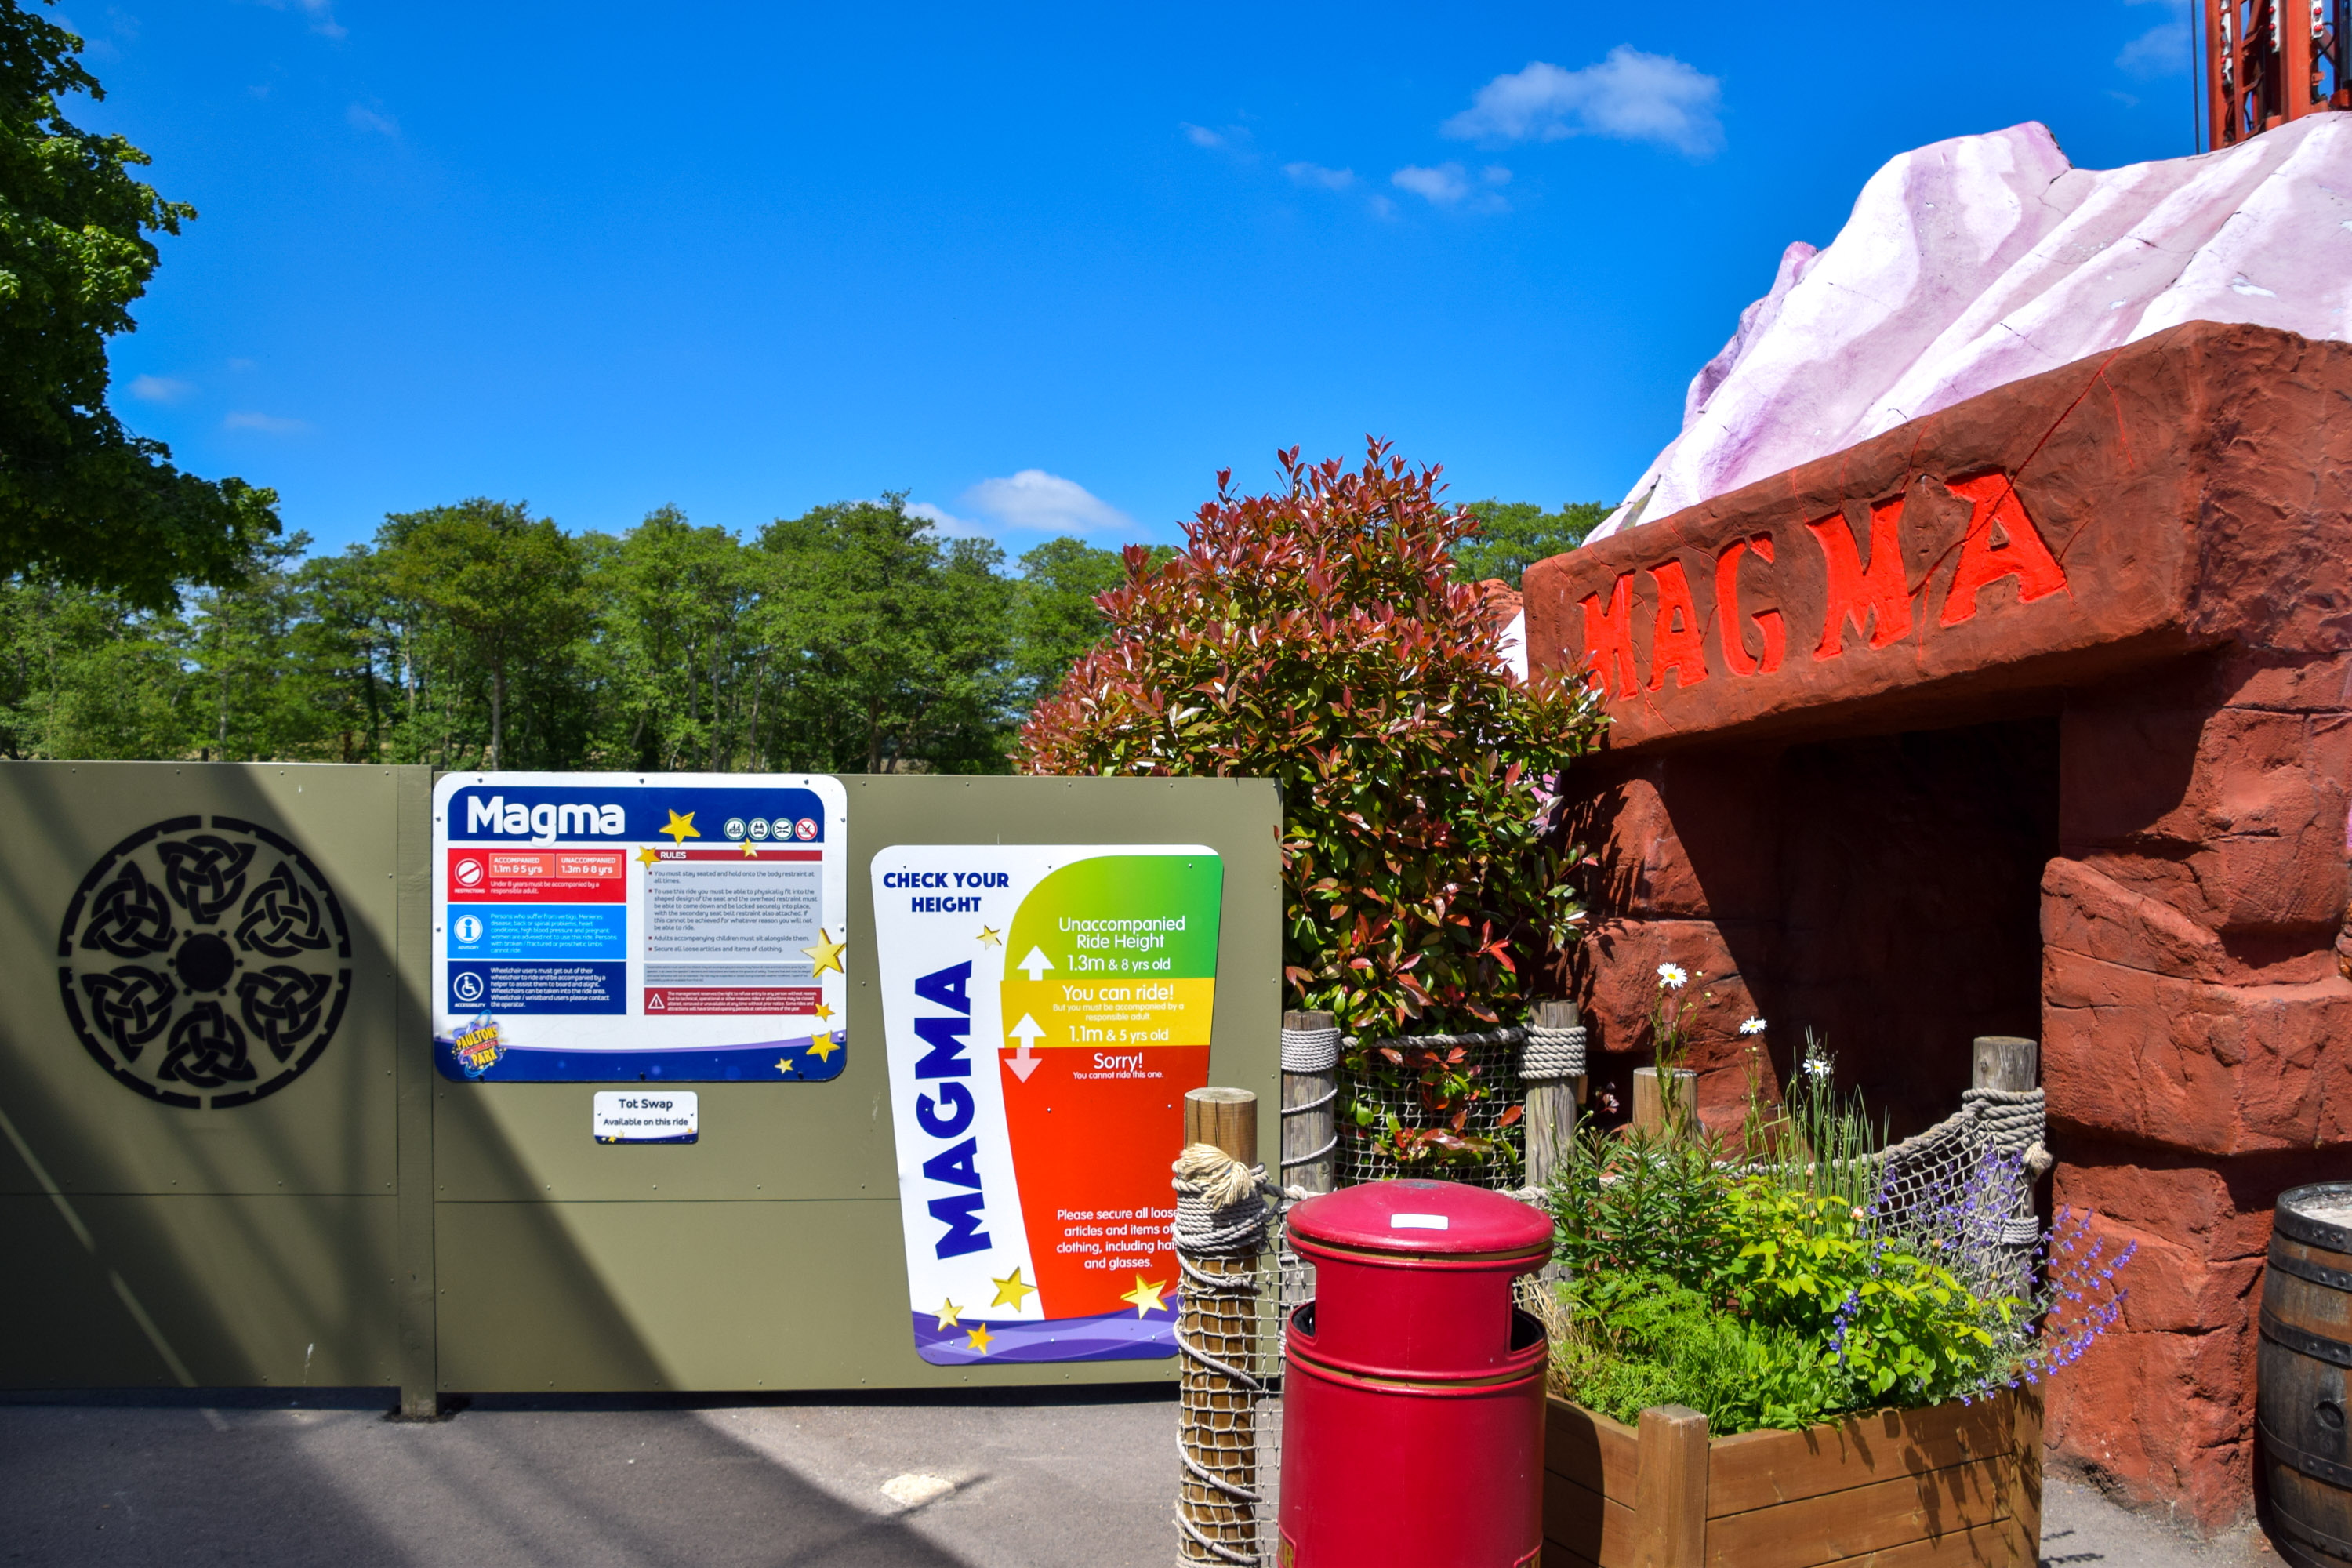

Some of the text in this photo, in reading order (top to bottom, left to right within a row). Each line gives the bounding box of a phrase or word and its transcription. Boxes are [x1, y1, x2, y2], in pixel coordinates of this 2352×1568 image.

[1577, 471, 2067, 702] MAGMA
[467, 795, 626, 847] Magma
[599, 867, 612, 876] yrs
[884, 873, 1008, 887] CHECK YOUR
[912, 897, 981, 912] HEIGHT
[1059, 916, 1185, 935] Unaccompanied
[1077, 931, 1164, 951] Ride Height
[1068, 955, 1171, 972] 1.3m & 8 yrs old
[1063, 983, 1173, 1001] You can ride!
[1115, 1002, 1167, 1013] accompanied
[1167, 1002, 1178, 1011] by
[1085, 1013, 1129, 1022] responsible
[456, 1027, 499, 1051] PAULTONS
[1069, 1025, 1168, 1044] 1.1m & 5 yrs old
[472, 1047, 498, 1066] PARK
[1094, 1052, 1142, 1072] Sorry!
[619, 1099, 673, 1111] Tot Swap
[915, 960, 993, 1260] MAGMA
[1058, 1209, 1093, 1220] Please
[1096, 1210, 1132, 1220] secure
[1135, 1207, 1148, 1218] all
[1065, 1225, 1102, 1236] articles
[1105, 1224, 1127, 1236] and
[1131, 1225, 1160, 1235] items
[1057, 1239, 1176, 1254] clothing, including hat
[1084, 1257, 1152, 1270] and glasses.
